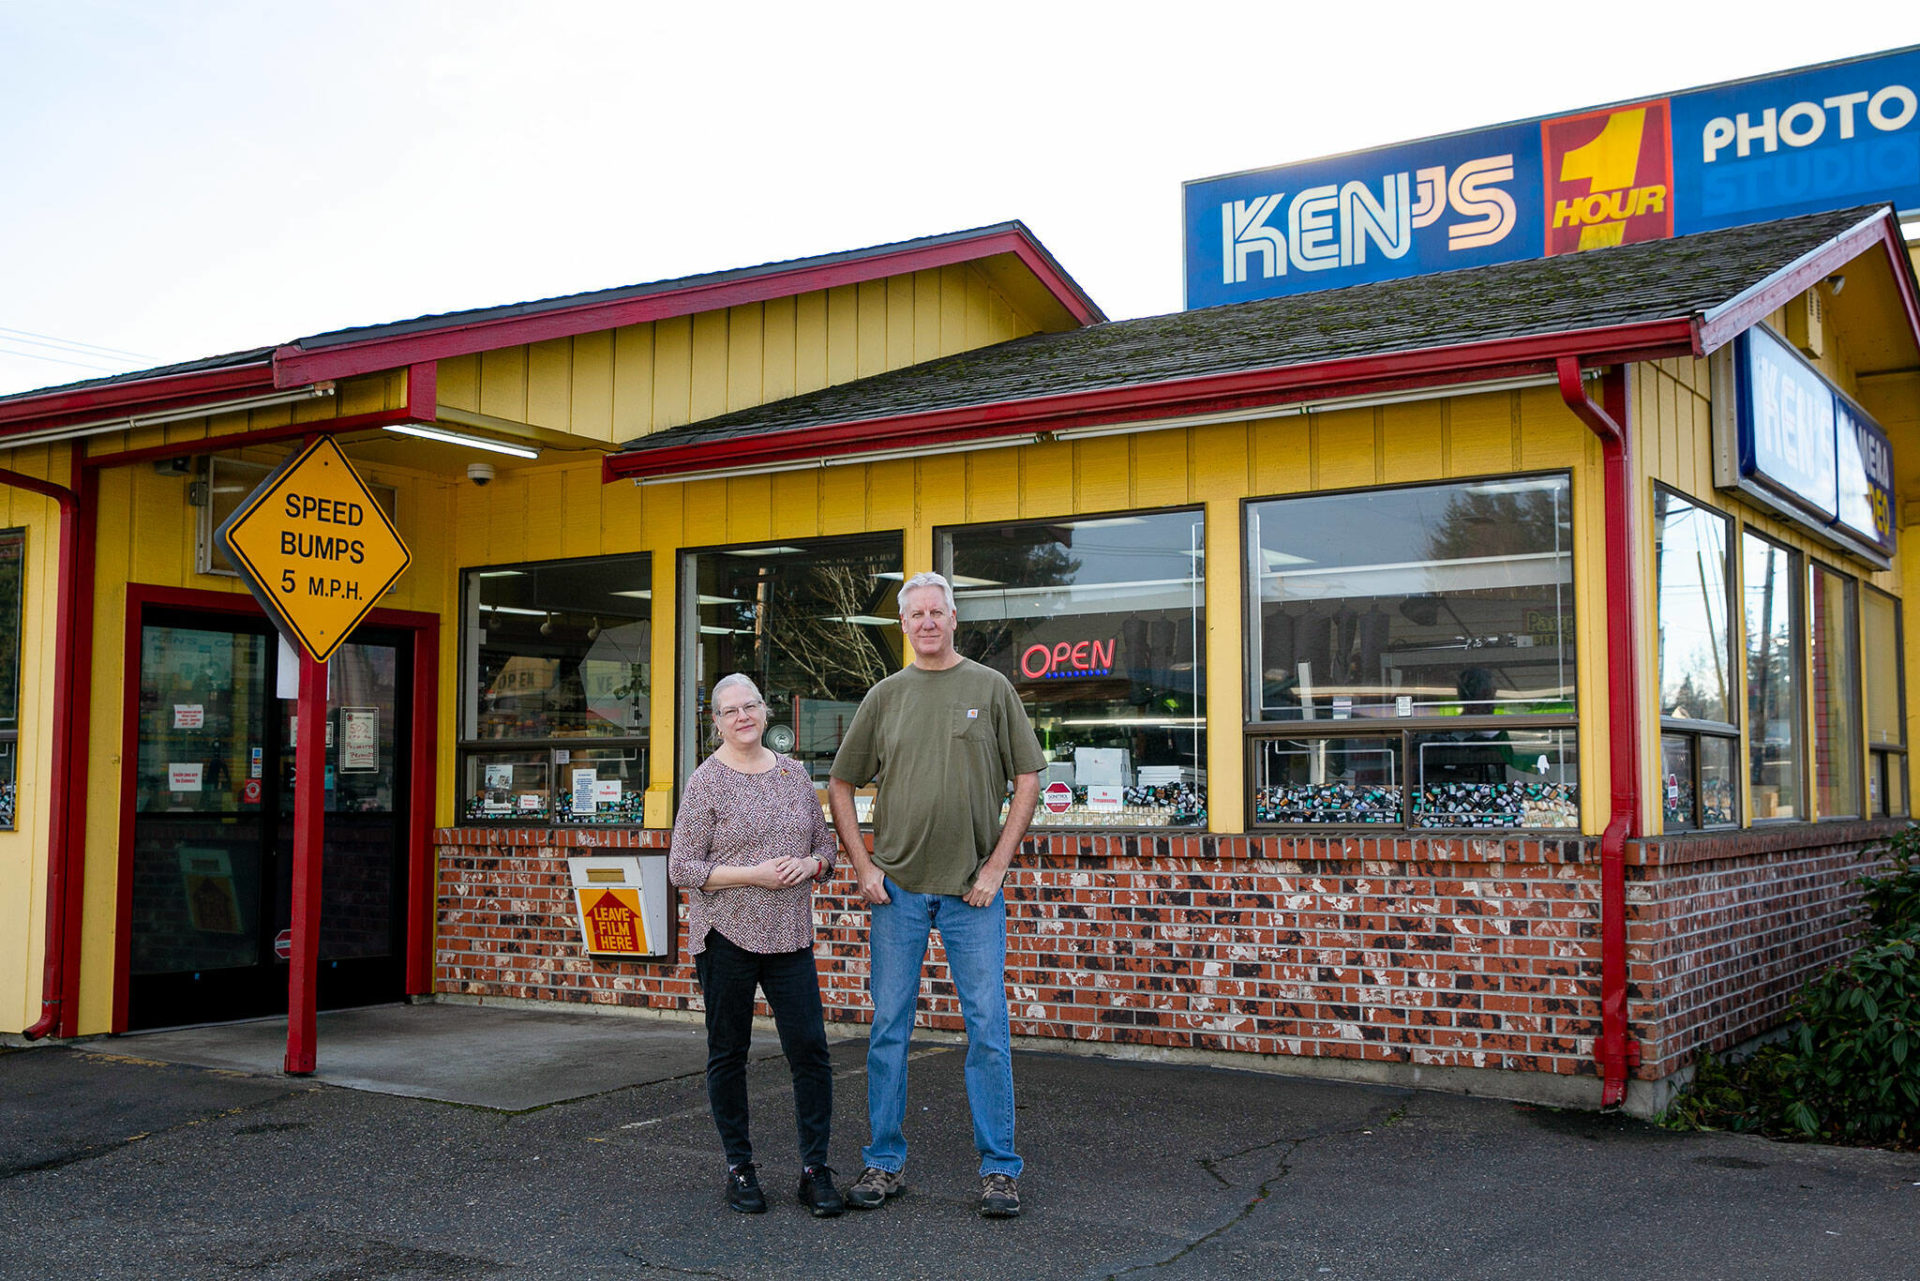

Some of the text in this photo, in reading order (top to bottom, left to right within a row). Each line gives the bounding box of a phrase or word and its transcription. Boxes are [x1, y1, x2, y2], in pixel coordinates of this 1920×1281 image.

[1703, 85, 1918, 163] PHOTO
[1704, 140, 1919, 212] STUDIO
[1221, 154, 1518, 285] KEN'S
[1552, 184, 1667, 229] HOUR
[284, 493, 364, 527] SPEED
[280, 531, 365, 565] BUMPS
[281, 569, 363, 601] 5 M.P.H.
[1021, 638, 1116, 679] OPEN
[593, 907, 631, 922] LEAVE
[599, 921, 631, 936] FILM
[600, 935, 634, 951] HERE
